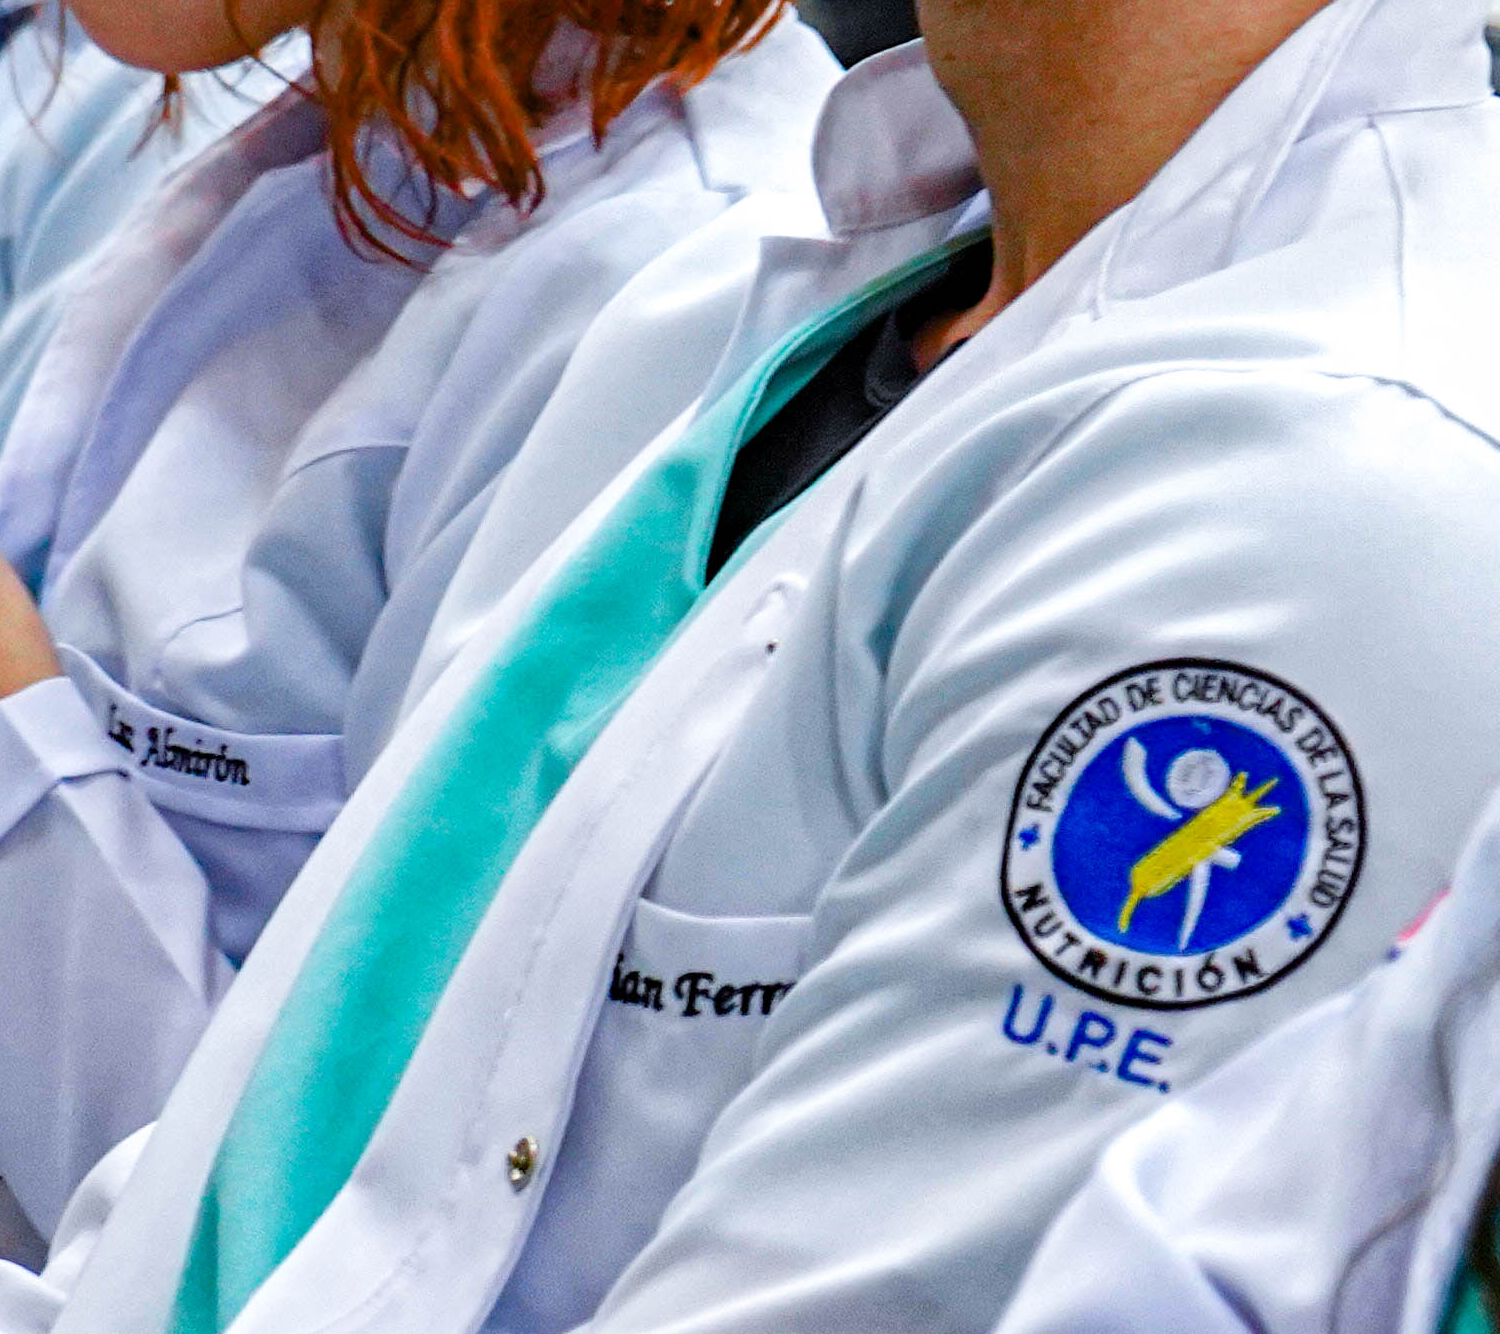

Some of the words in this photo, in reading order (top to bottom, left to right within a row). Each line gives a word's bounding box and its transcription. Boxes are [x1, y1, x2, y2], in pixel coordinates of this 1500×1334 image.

[1125, 682, 1163, 713] DE
[1171, 670, 1301, 735] CIENCIAS
[1027, 697, 1120, 813] FACULTAD
[1296, 727, 1341, 765] DE
[1319, 765, 1352, 809] LA
[1319, 815, 1358, 910] SALUD
[1014, 885, 1267, 998] NUTRICIÓN
[1001, 984, 1173, 1093] U.P.E.
